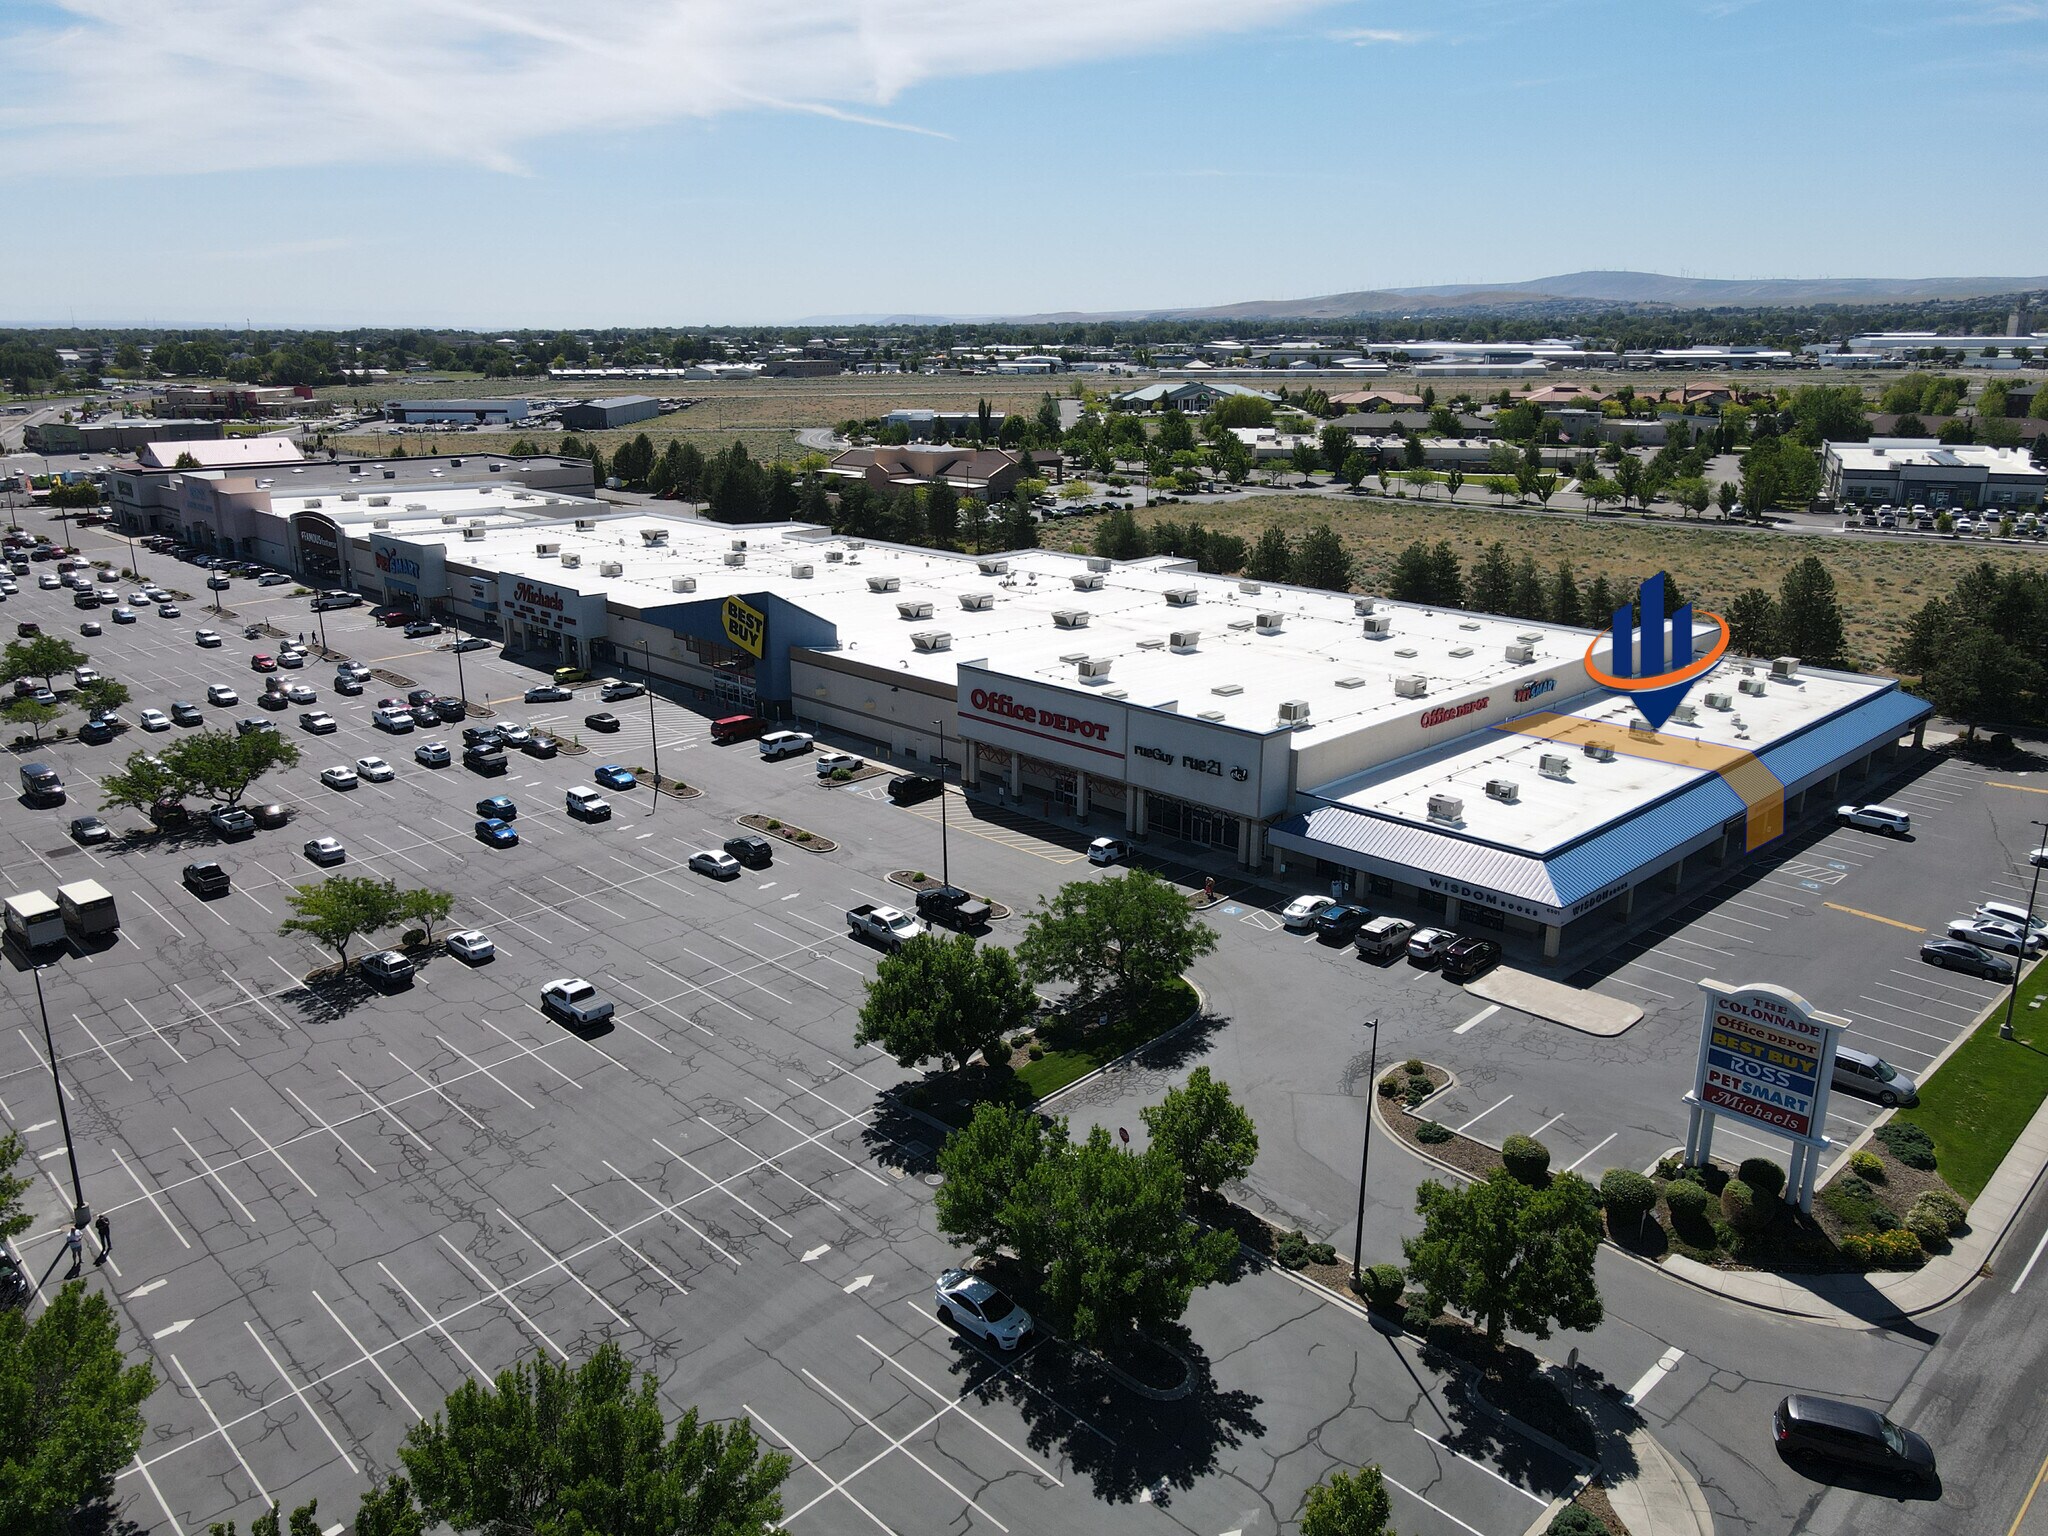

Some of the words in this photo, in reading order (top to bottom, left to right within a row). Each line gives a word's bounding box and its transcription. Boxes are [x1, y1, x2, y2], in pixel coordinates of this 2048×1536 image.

[514, 582, 564, 612] Michaels
[728, 601, 762, 634] BEST
[729, 618, 759, 647] BUY
[971, 688, 1036, 723] Office
[1039, 709, 1109, 741] DEPOT
[1421, 705, 1456, 728] Office
[1456, 697, 1490, 718] DEPOT
[1134, 745, 1174, 766] rueGuy
[1182, 755, 1223, 777] rue21
[1429, 877, 1497, 905] WISDOM
[1501, 901, 1538, 917] BOOKS
[1573, 890, 1609, 916] WISDOM
[1719, 999, 1820, 1037] COLONNADE
[1754, 998, 1787, 1015] THE
[1717, 1015, 1765, 1038] Office
[1767, 1031, 1816, 1054] DEPOT
[1713, 1032, 1765, 1056] BEST
[1767, 1050, 1816, 1073] BUY
[1730, 1057, 1790, 1088] ROSS
[1709, 1070, 1809, 1113] PETSMART
[1712, 1091, 1800, 1129] Michaels
